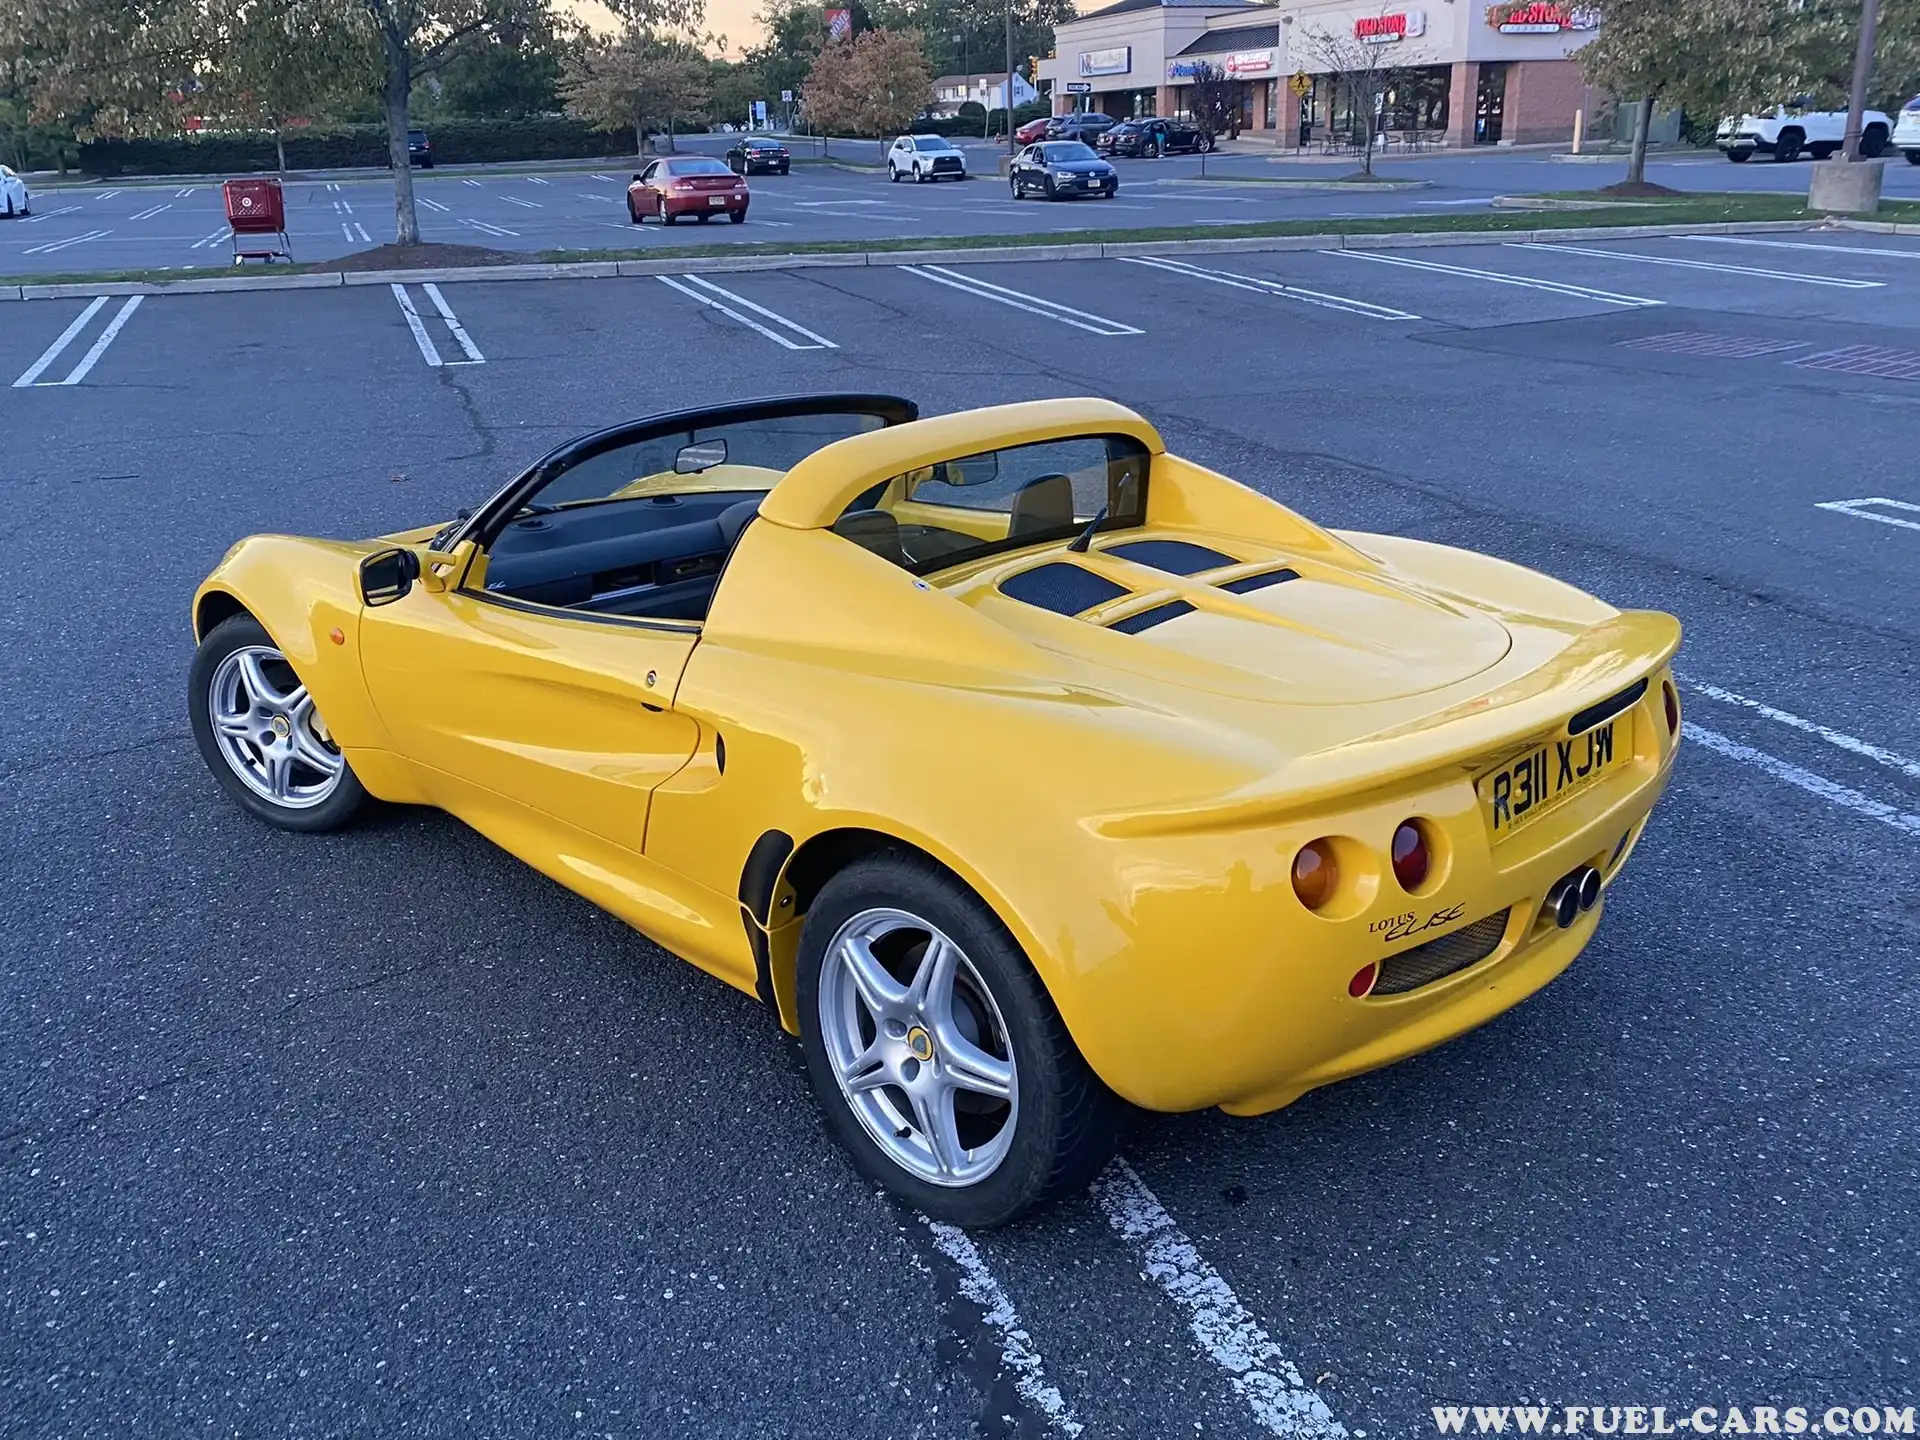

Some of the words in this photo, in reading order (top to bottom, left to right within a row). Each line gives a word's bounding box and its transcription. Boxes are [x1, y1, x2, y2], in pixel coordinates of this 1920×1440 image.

[1378, 14, 1406, 36] STONE
[1493, 748, 1548, 830] R311
[1556, 722, 1614, 791] XJW
[1369, 911, 1415, 933] LOTUS
[1384, 902, 1466, 942] ELISE
